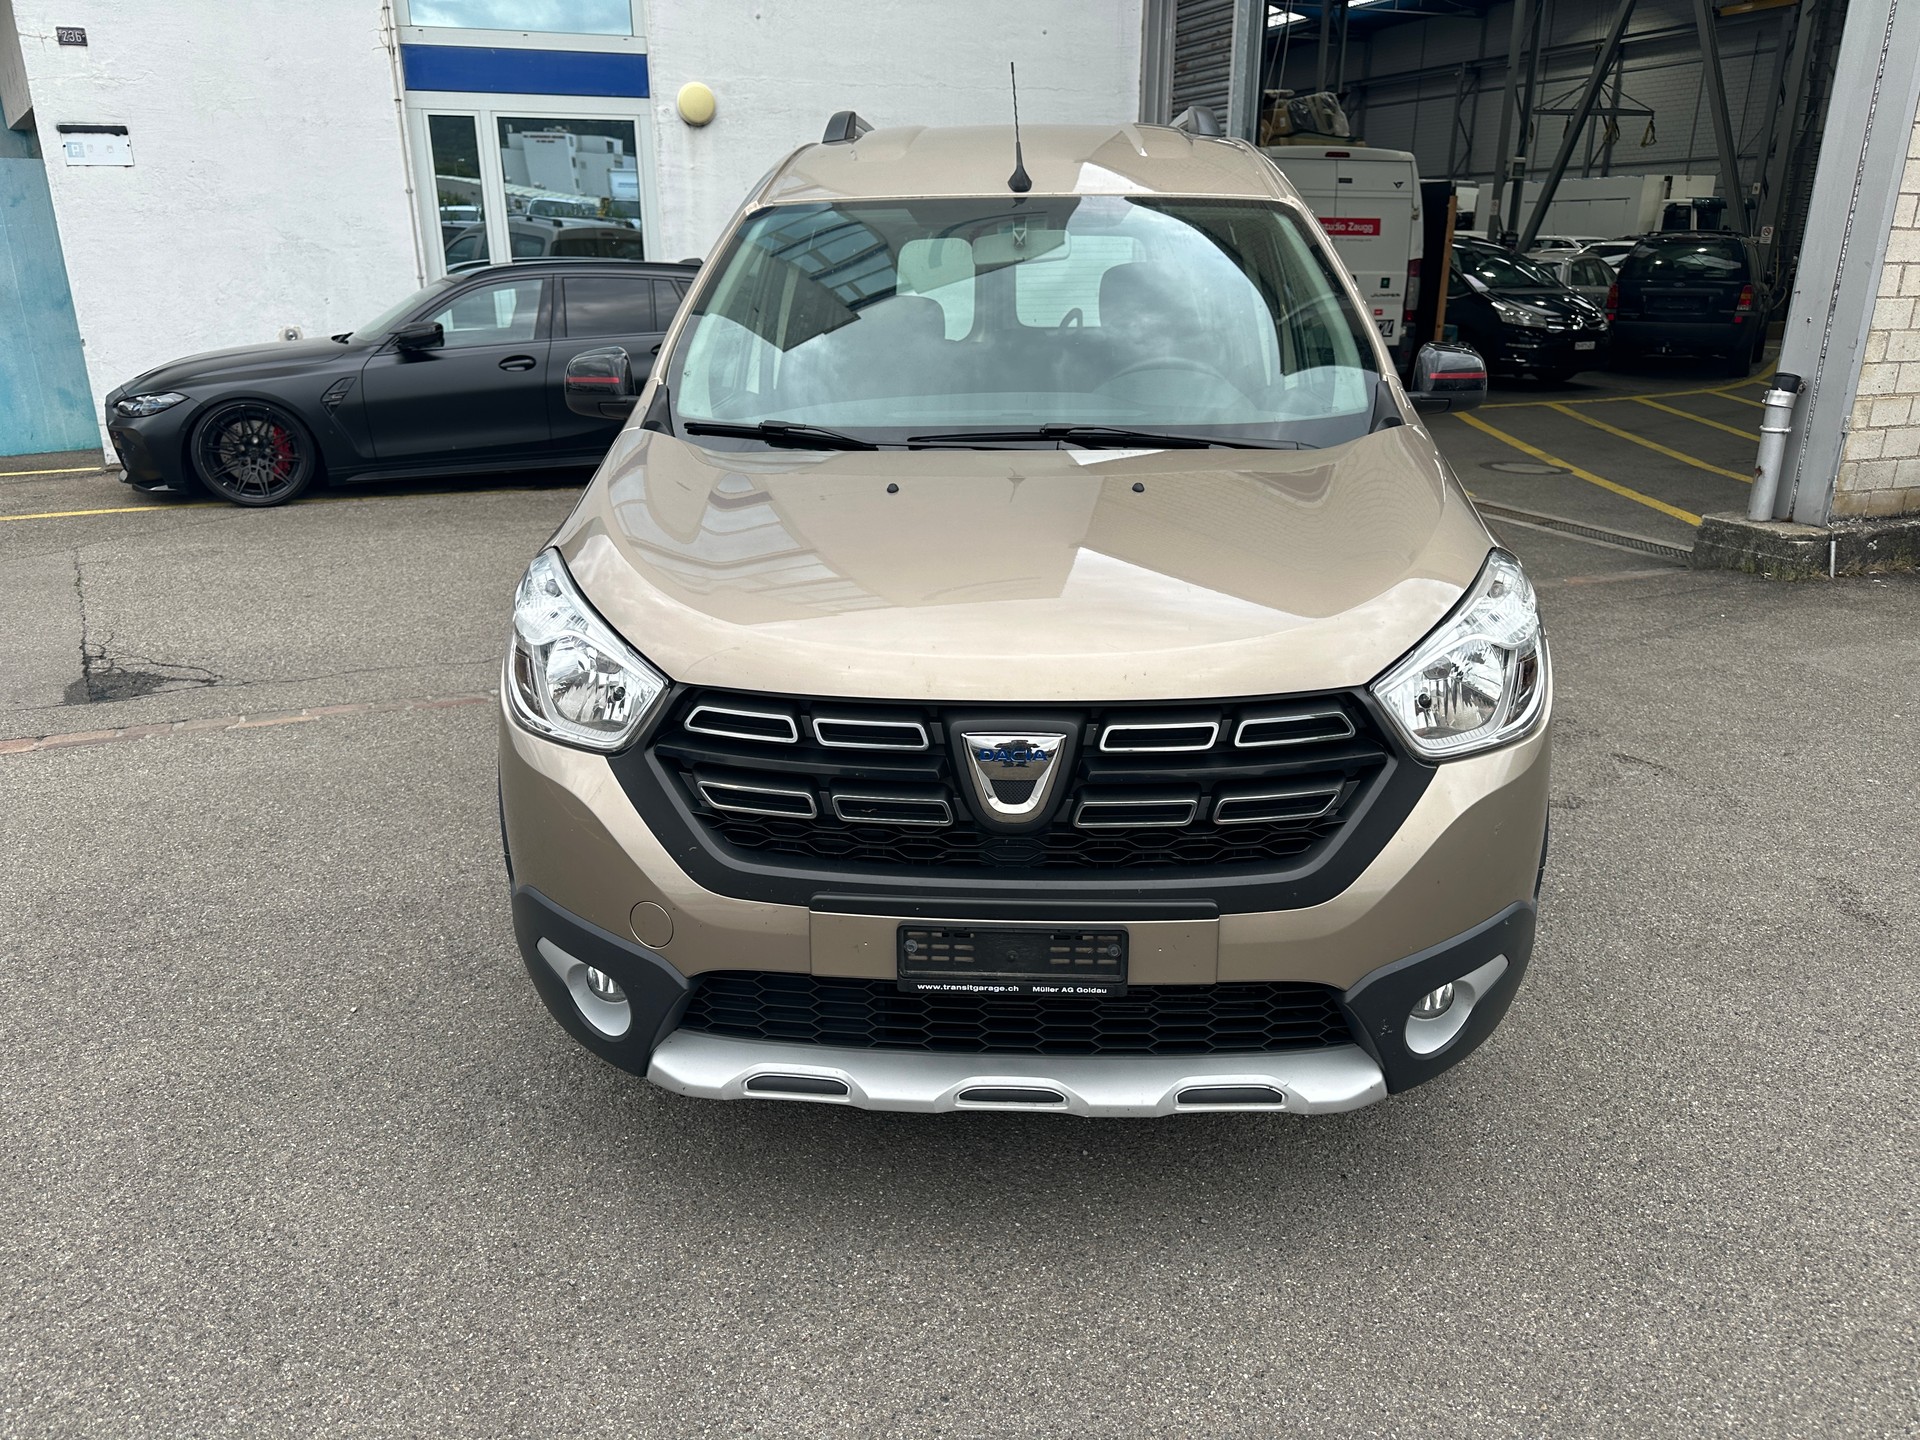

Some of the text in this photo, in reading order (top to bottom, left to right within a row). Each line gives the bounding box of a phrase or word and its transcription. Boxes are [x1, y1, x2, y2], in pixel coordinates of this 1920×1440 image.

[61, 30, 82, 42] 236
[1347, 222, 1374, 234] Zaugg
[979, 748, 1048, 762] DACIA
[917, 984, 1020, 993] www.transitgarage.ch
